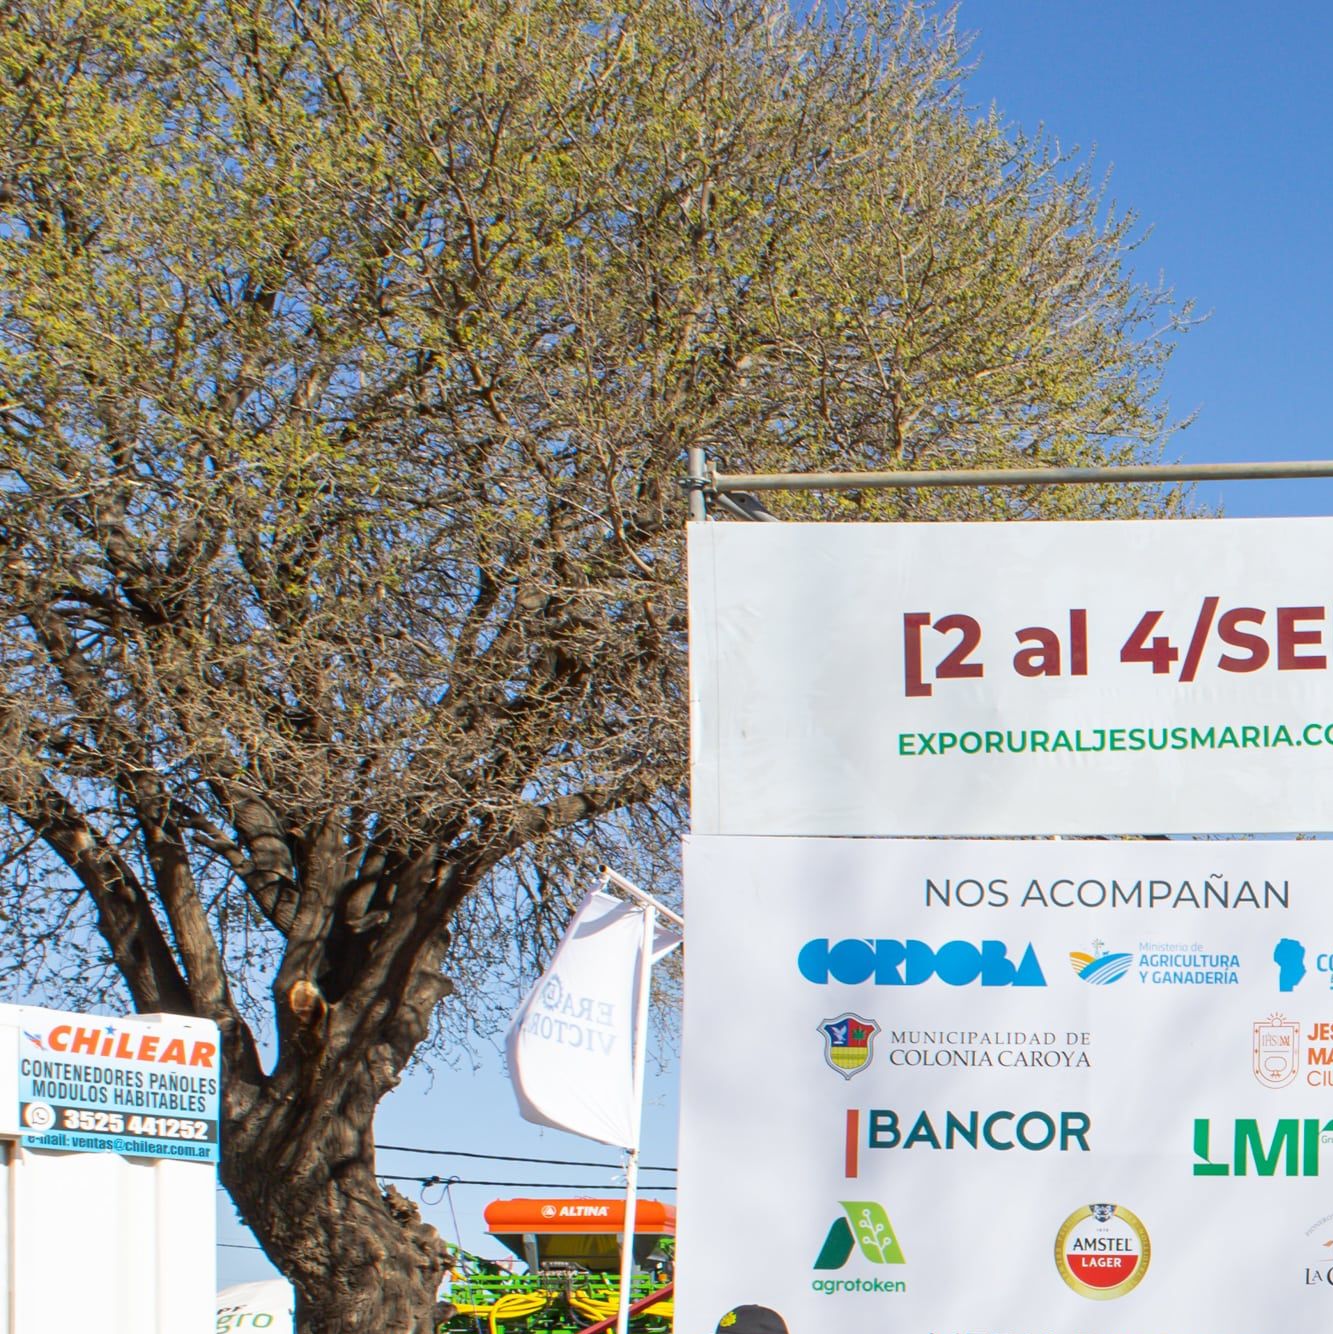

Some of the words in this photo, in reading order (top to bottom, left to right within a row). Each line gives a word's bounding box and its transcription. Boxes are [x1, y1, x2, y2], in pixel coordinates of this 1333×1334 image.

[1012, 608, 1088, 678] al
[925, 879, 1009, 907] NOS
[1021, 873, 1291, 909] ACOMPAÑAN
[1139, 942, 1189, 952] Ministerio
[1192, 942, 1204, 952] de
[1139, 954, 1240, 968] AGRICULTURA
[1139, 971, 1148, 984] Y
[1152, 968, 1239, 985] GANADERÍA
[891, 1031, 1056, 1045] MUNICIPALIDAD
[1066, 1032, 1091, 1046] DE
[889, 1049, 993, 1066] COLONIA
[998, 1050, 1091, 1068] CAROYA
[21, 1058, 144, 1088] CONTENEDORES
[150, 1071, 217, 1095] PAÑOLES
[33, 1080, 108, 1103] MODULOS
[114, 1089, 206, 1112] HABITABLES
[64, 1109, 125, 1133] 3525
[127, 1116, 208, 1140] 441252
[868, 1109, 1091, 1152] BANCOR
[72, 1135, 210, 1157] ventas@chilear.com.ar
[559, 1206, 608, 1217] ALTINA
[1073, 1238, 1132, 1252] AMSTEL
[1082, 1257, 1122, 1268] LAGER
[811, 1277, 907, 1296] agrotoken
